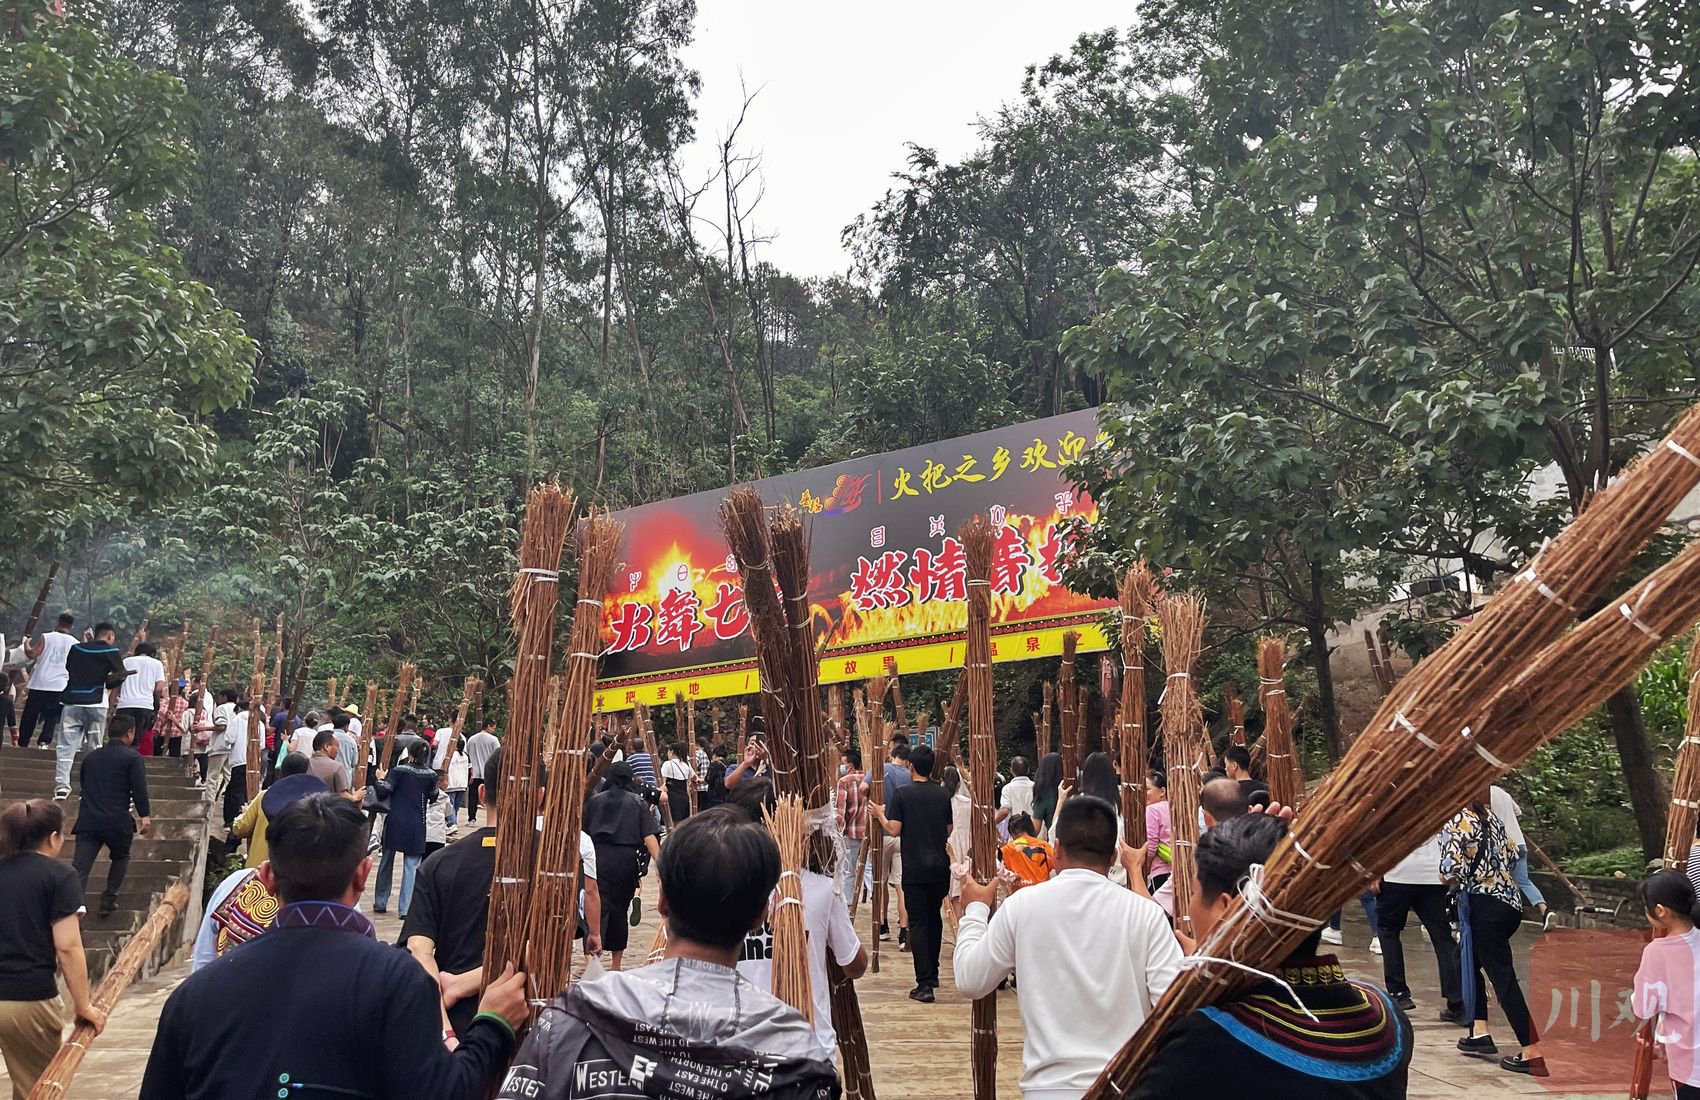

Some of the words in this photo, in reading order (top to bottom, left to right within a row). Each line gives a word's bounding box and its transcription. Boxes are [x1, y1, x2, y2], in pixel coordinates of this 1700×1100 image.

[605, 582, 788, 654] 火舞七
[632, 1034, 657, 1046] WEST
[674, 1069, 699, 1083] EAST
[705, 1065, 722, 1078] THE
[668, 1081, 695, 1099] WEST
[700, 1079, 719, 1091] THE
